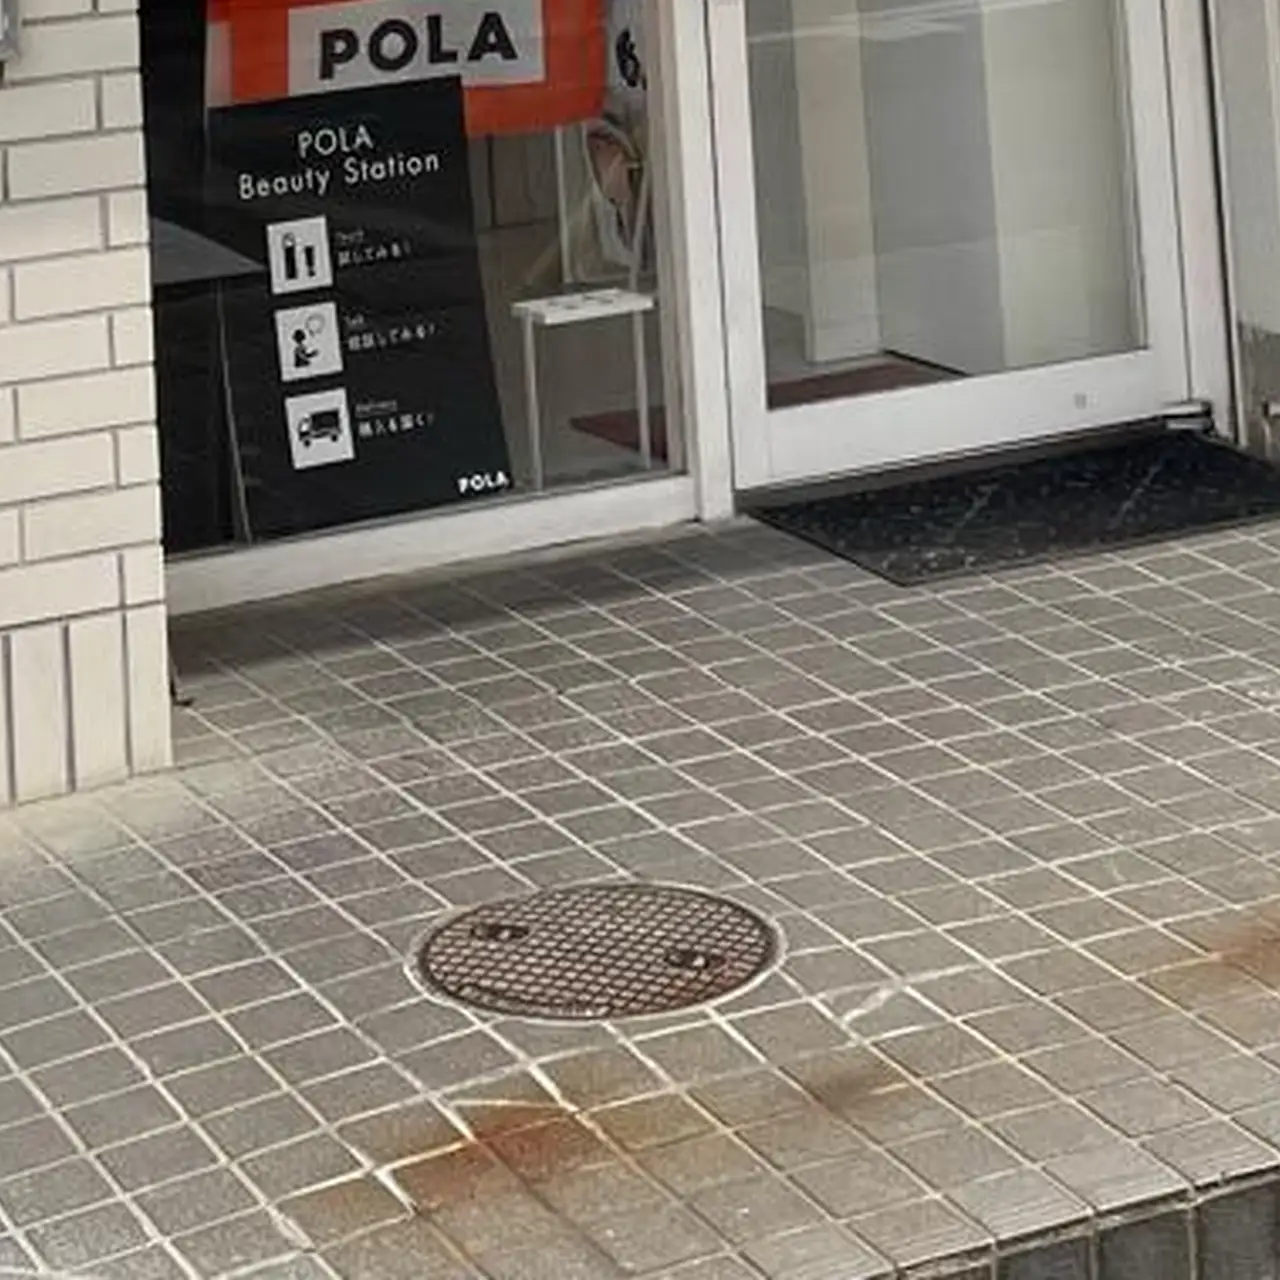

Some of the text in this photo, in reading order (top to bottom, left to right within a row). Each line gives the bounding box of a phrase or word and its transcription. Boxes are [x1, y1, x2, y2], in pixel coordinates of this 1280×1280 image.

[319, 11, 518, 80] POLA
[297, 124, 374, 159] POLA
[238, 152, 440, 200] Beauty Station
[457, 470, 510, 494] POLA
